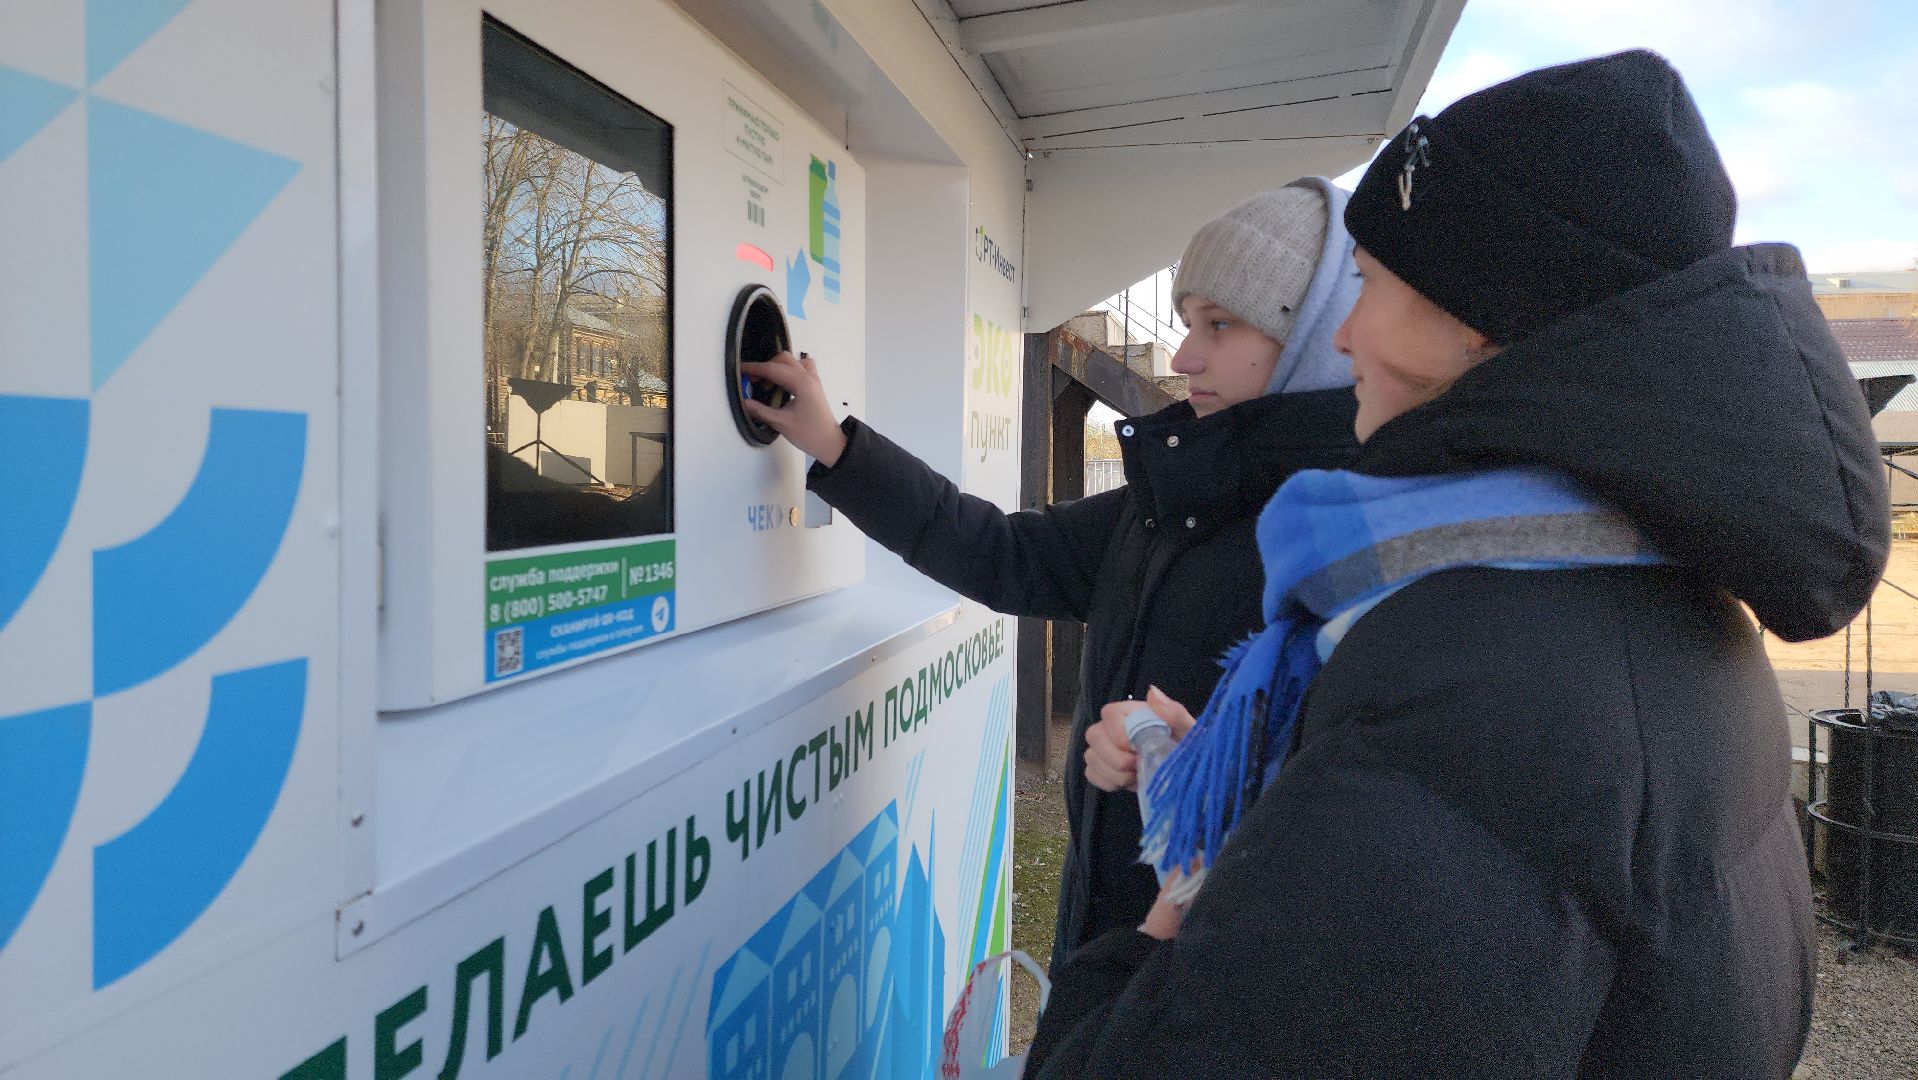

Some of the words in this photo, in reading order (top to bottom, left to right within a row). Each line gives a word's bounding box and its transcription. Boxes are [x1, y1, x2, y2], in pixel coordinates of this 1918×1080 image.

[747, 504, 774, 532] ЧЕК
[489, 566, 546, 593] служба
[548, 560, 620, 584] поддержки
[489, 603, 500, 623] 8
[503, 595, 545, 623] (800)
[547, 585, 609, 612] 500-5747
[277, 813, 711, 1080] ЕЛАЕШЬ
[726, 700, 873, 862] ЧИСТЫМ
[884, 617, 1004, 749] ПОДМОСКОВЬЕ!
